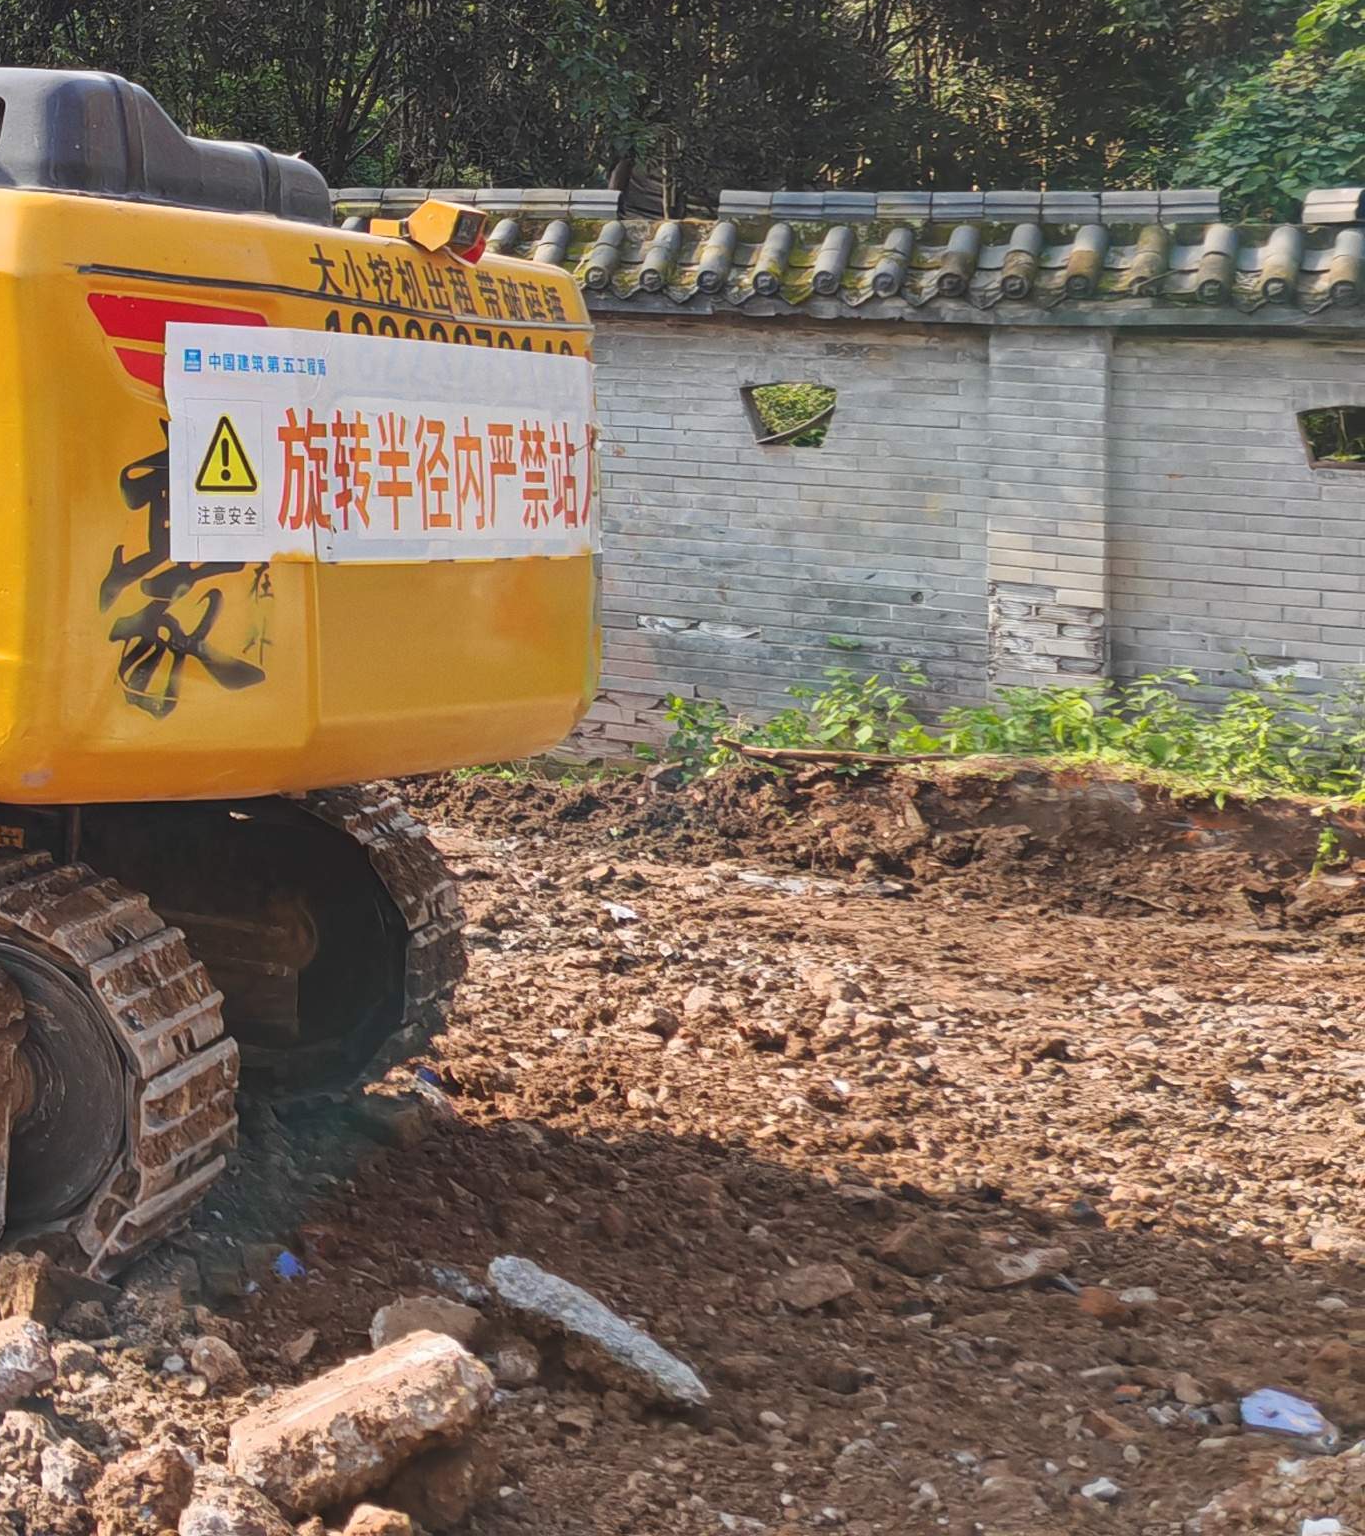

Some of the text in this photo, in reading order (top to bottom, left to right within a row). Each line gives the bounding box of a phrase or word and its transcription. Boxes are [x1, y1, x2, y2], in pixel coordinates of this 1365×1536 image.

[309, 243, 475, 315] 大小挖机出租
[209, 352, 326, 376] 中国建筑第五工程局
[197, 506, 257, 525] 注意安全
